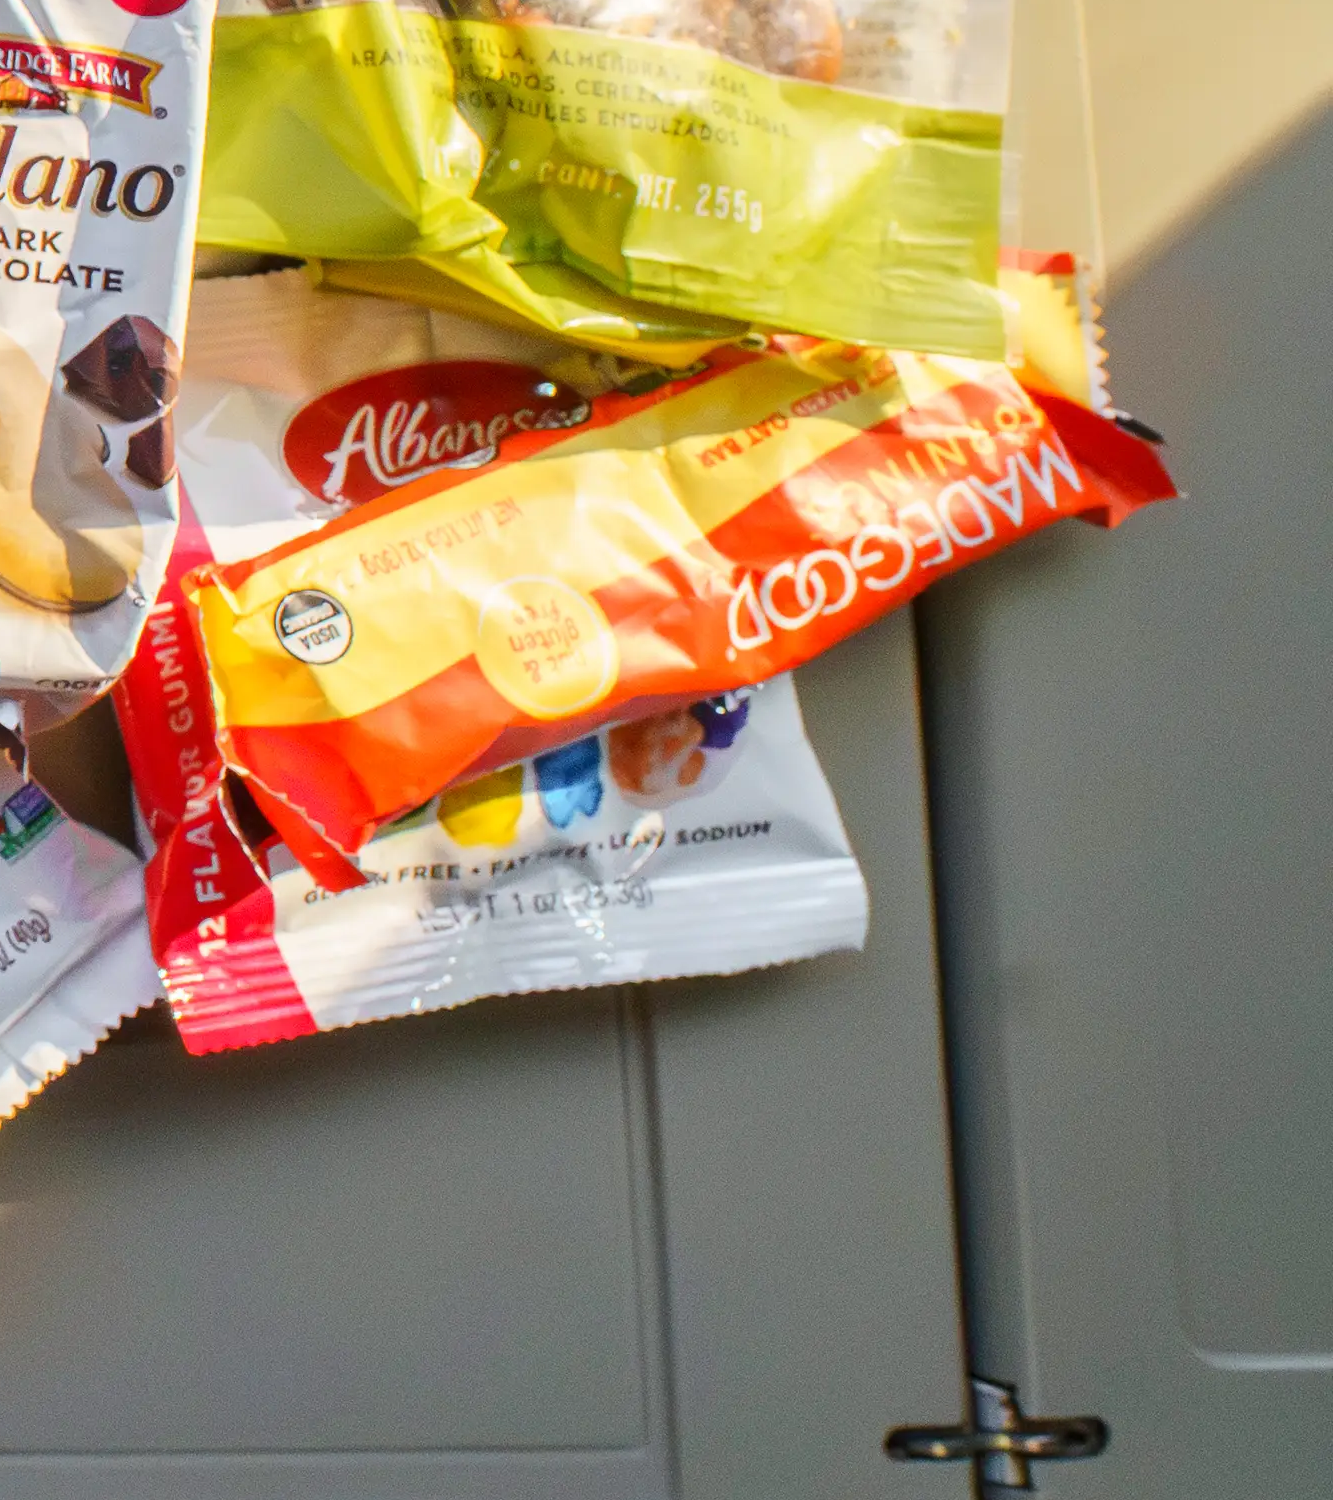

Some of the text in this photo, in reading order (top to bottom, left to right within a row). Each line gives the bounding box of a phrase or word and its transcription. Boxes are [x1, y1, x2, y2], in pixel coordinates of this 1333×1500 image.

[68, 55, 132, 94] FARM
[538, 159, 622, 199] CONT.
[634, 172, 682, 214] NET.
[694, 183, 764, 235] 255g
[746, 412, 791, 448] OAT
[695, 441, 743, 468] BAR
[726, 438, 1084, 652] MADEGOOD
[298, 623, 341, 652] USDA
[508, 618, 581, 653] gluten
[148, 601, 227, 958] 12 FLAVOR GUMMI
[397, 864, 460, 884] FREE
[488, 857, 527, 877] FAT
[674, 819, 773, 847] SODIUM
